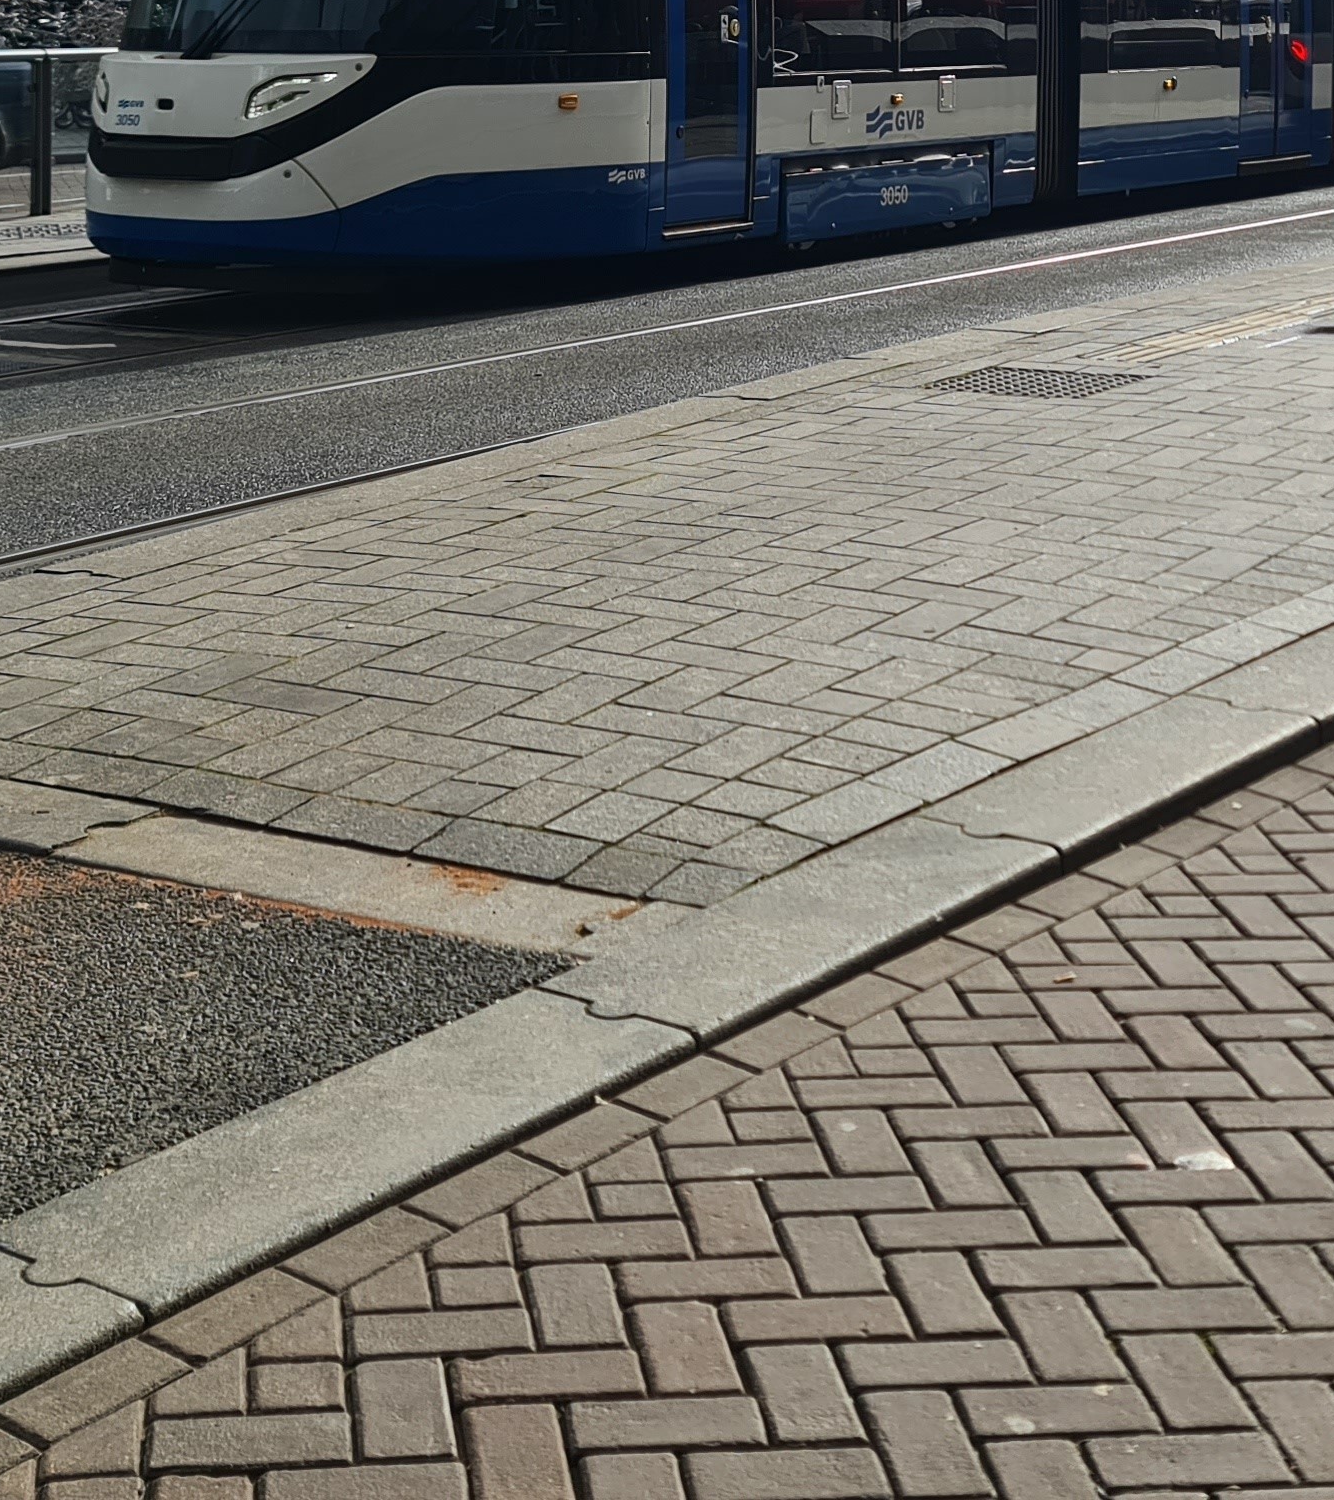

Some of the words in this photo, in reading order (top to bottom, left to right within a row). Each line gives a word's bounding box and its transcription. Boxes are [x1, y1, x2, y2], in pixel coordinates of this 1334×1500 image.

[115, 114, 141, 126] 3050
[895, 109, 925, 132] GVB
[627, 168, 646, 180] GVB
[880, 184, 908, 206] 3050
